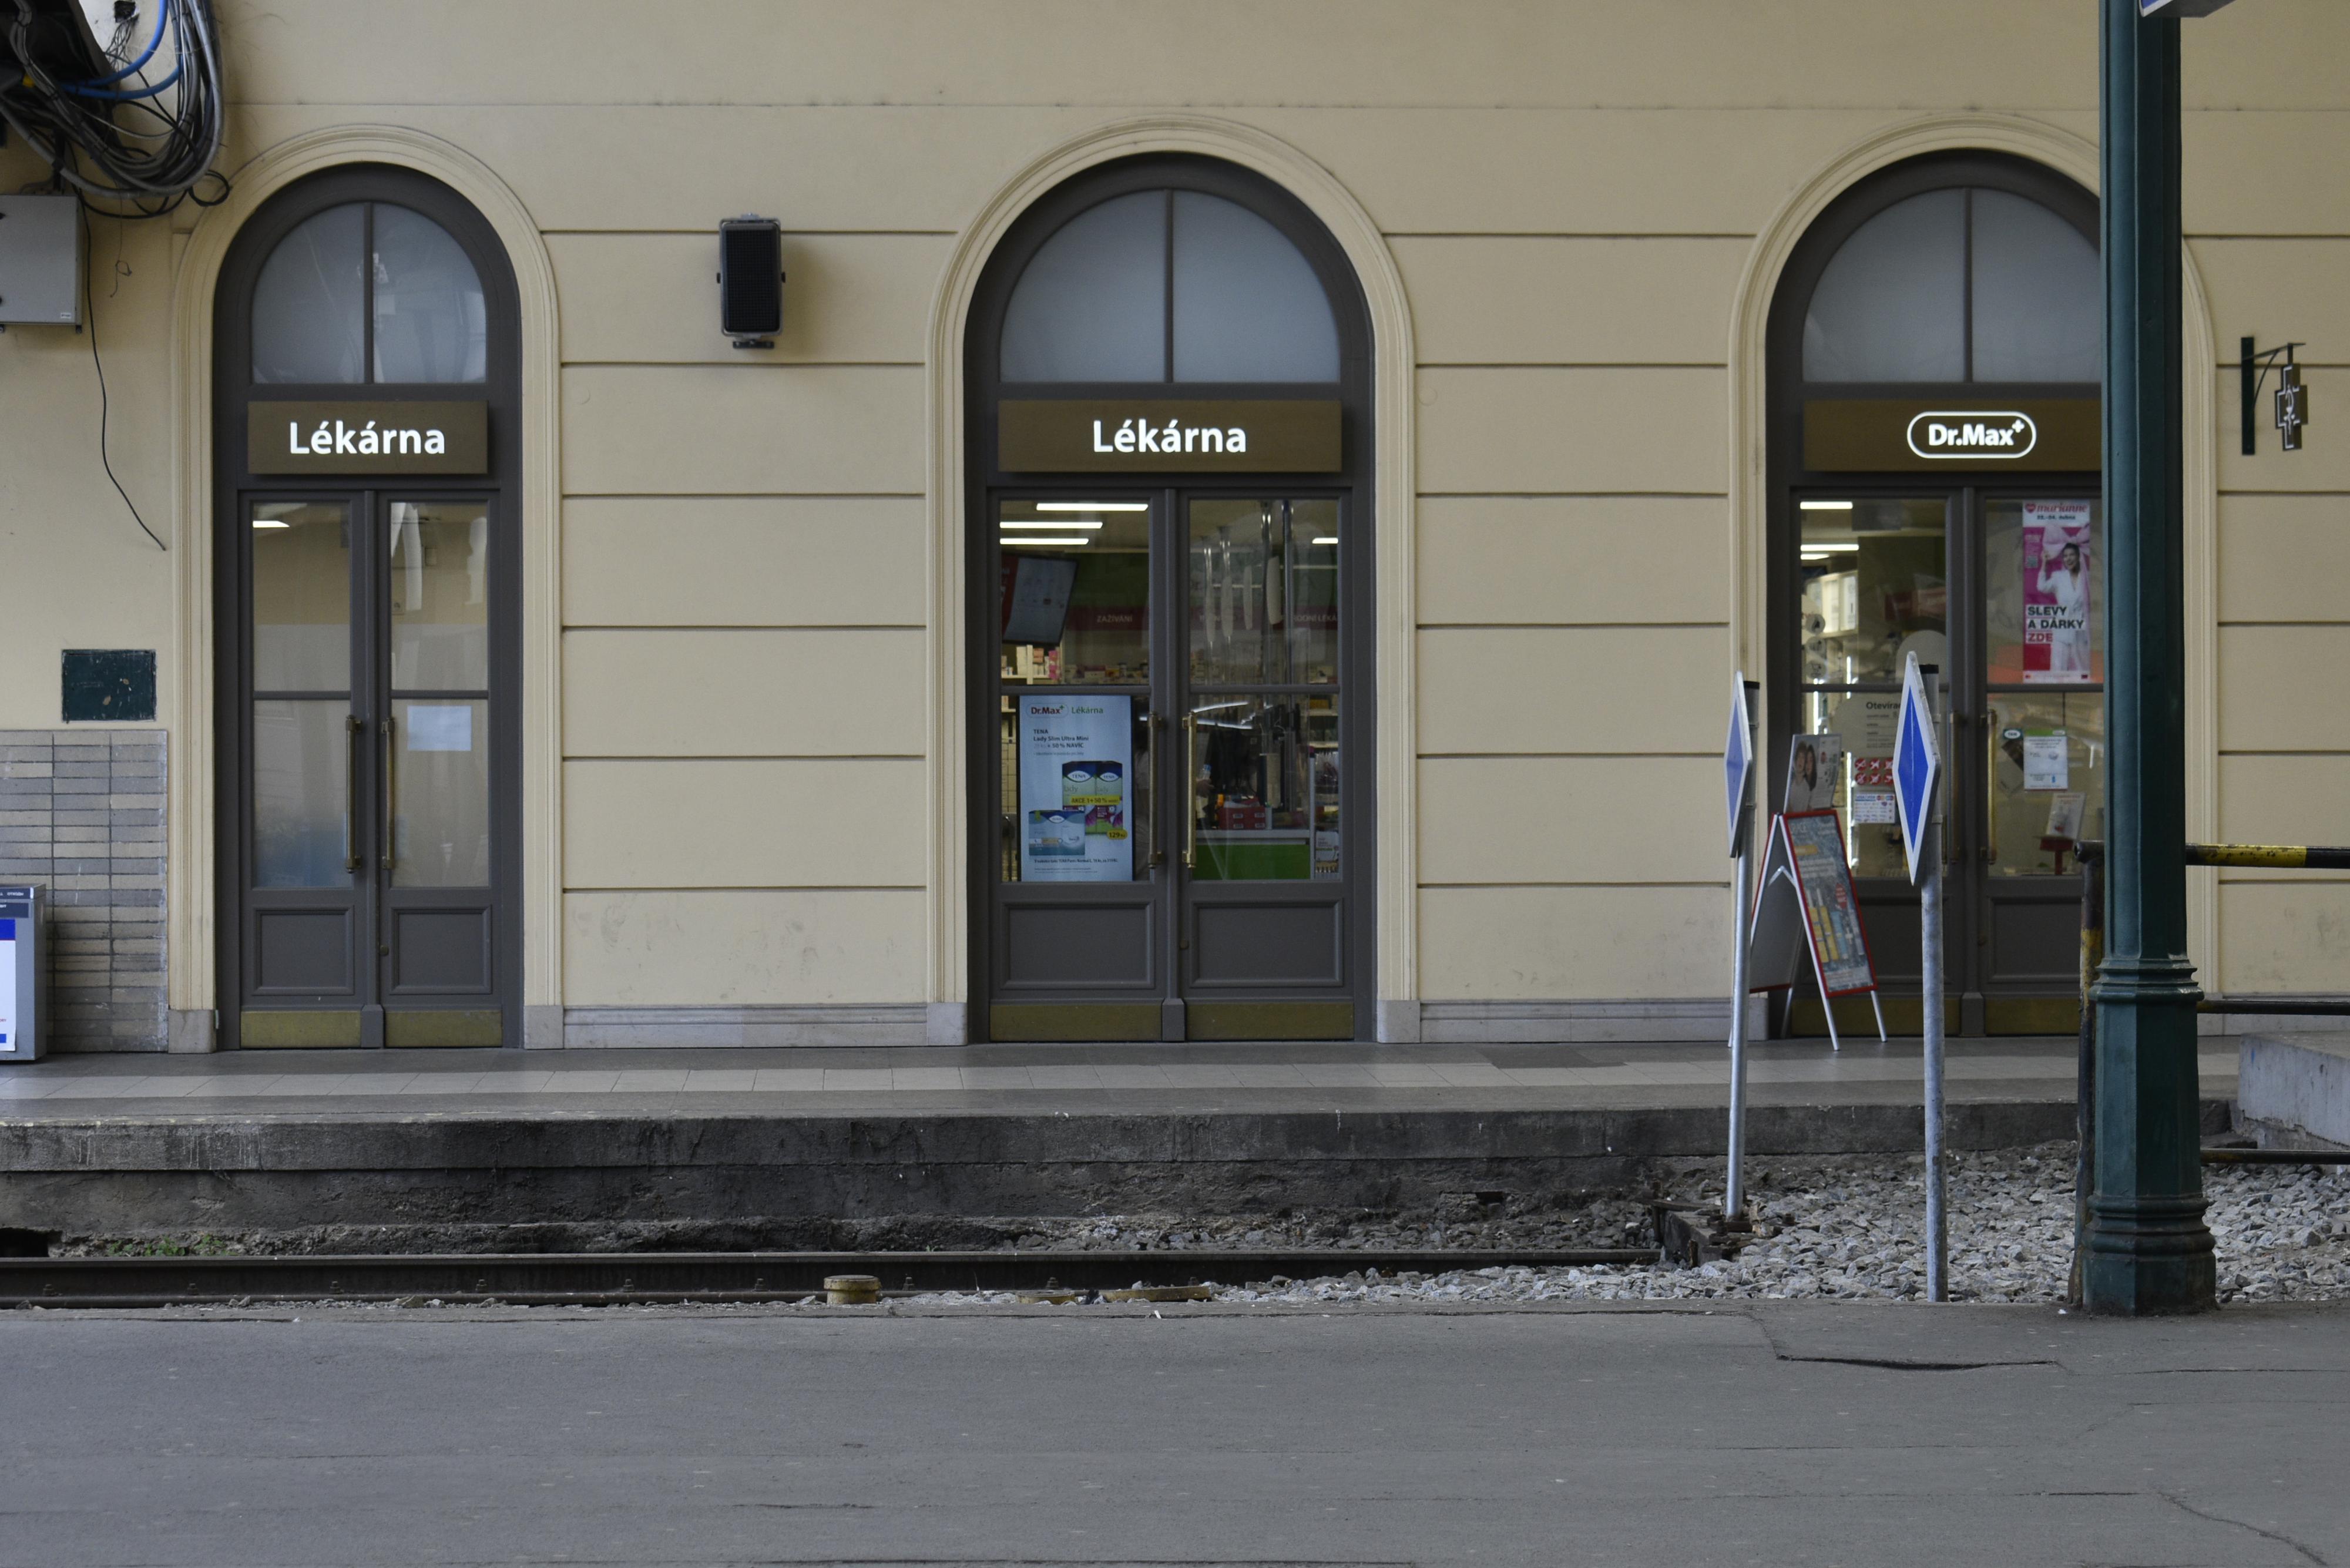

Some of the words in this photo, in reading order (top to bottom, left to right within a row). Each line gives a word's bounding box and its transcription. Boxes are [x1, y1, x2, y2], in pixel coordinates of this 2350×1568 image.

[290, 420, 445, 455] Lékárna
[1093, 418, 1246, 453] Lékárna
[2028, 606, 2067, 616] SLEVY
[2028, 620, 2036, 629] A
[2041, 617, 2084, 629] DÁRKY
[2028, 633, 2053, 642] ZDE
